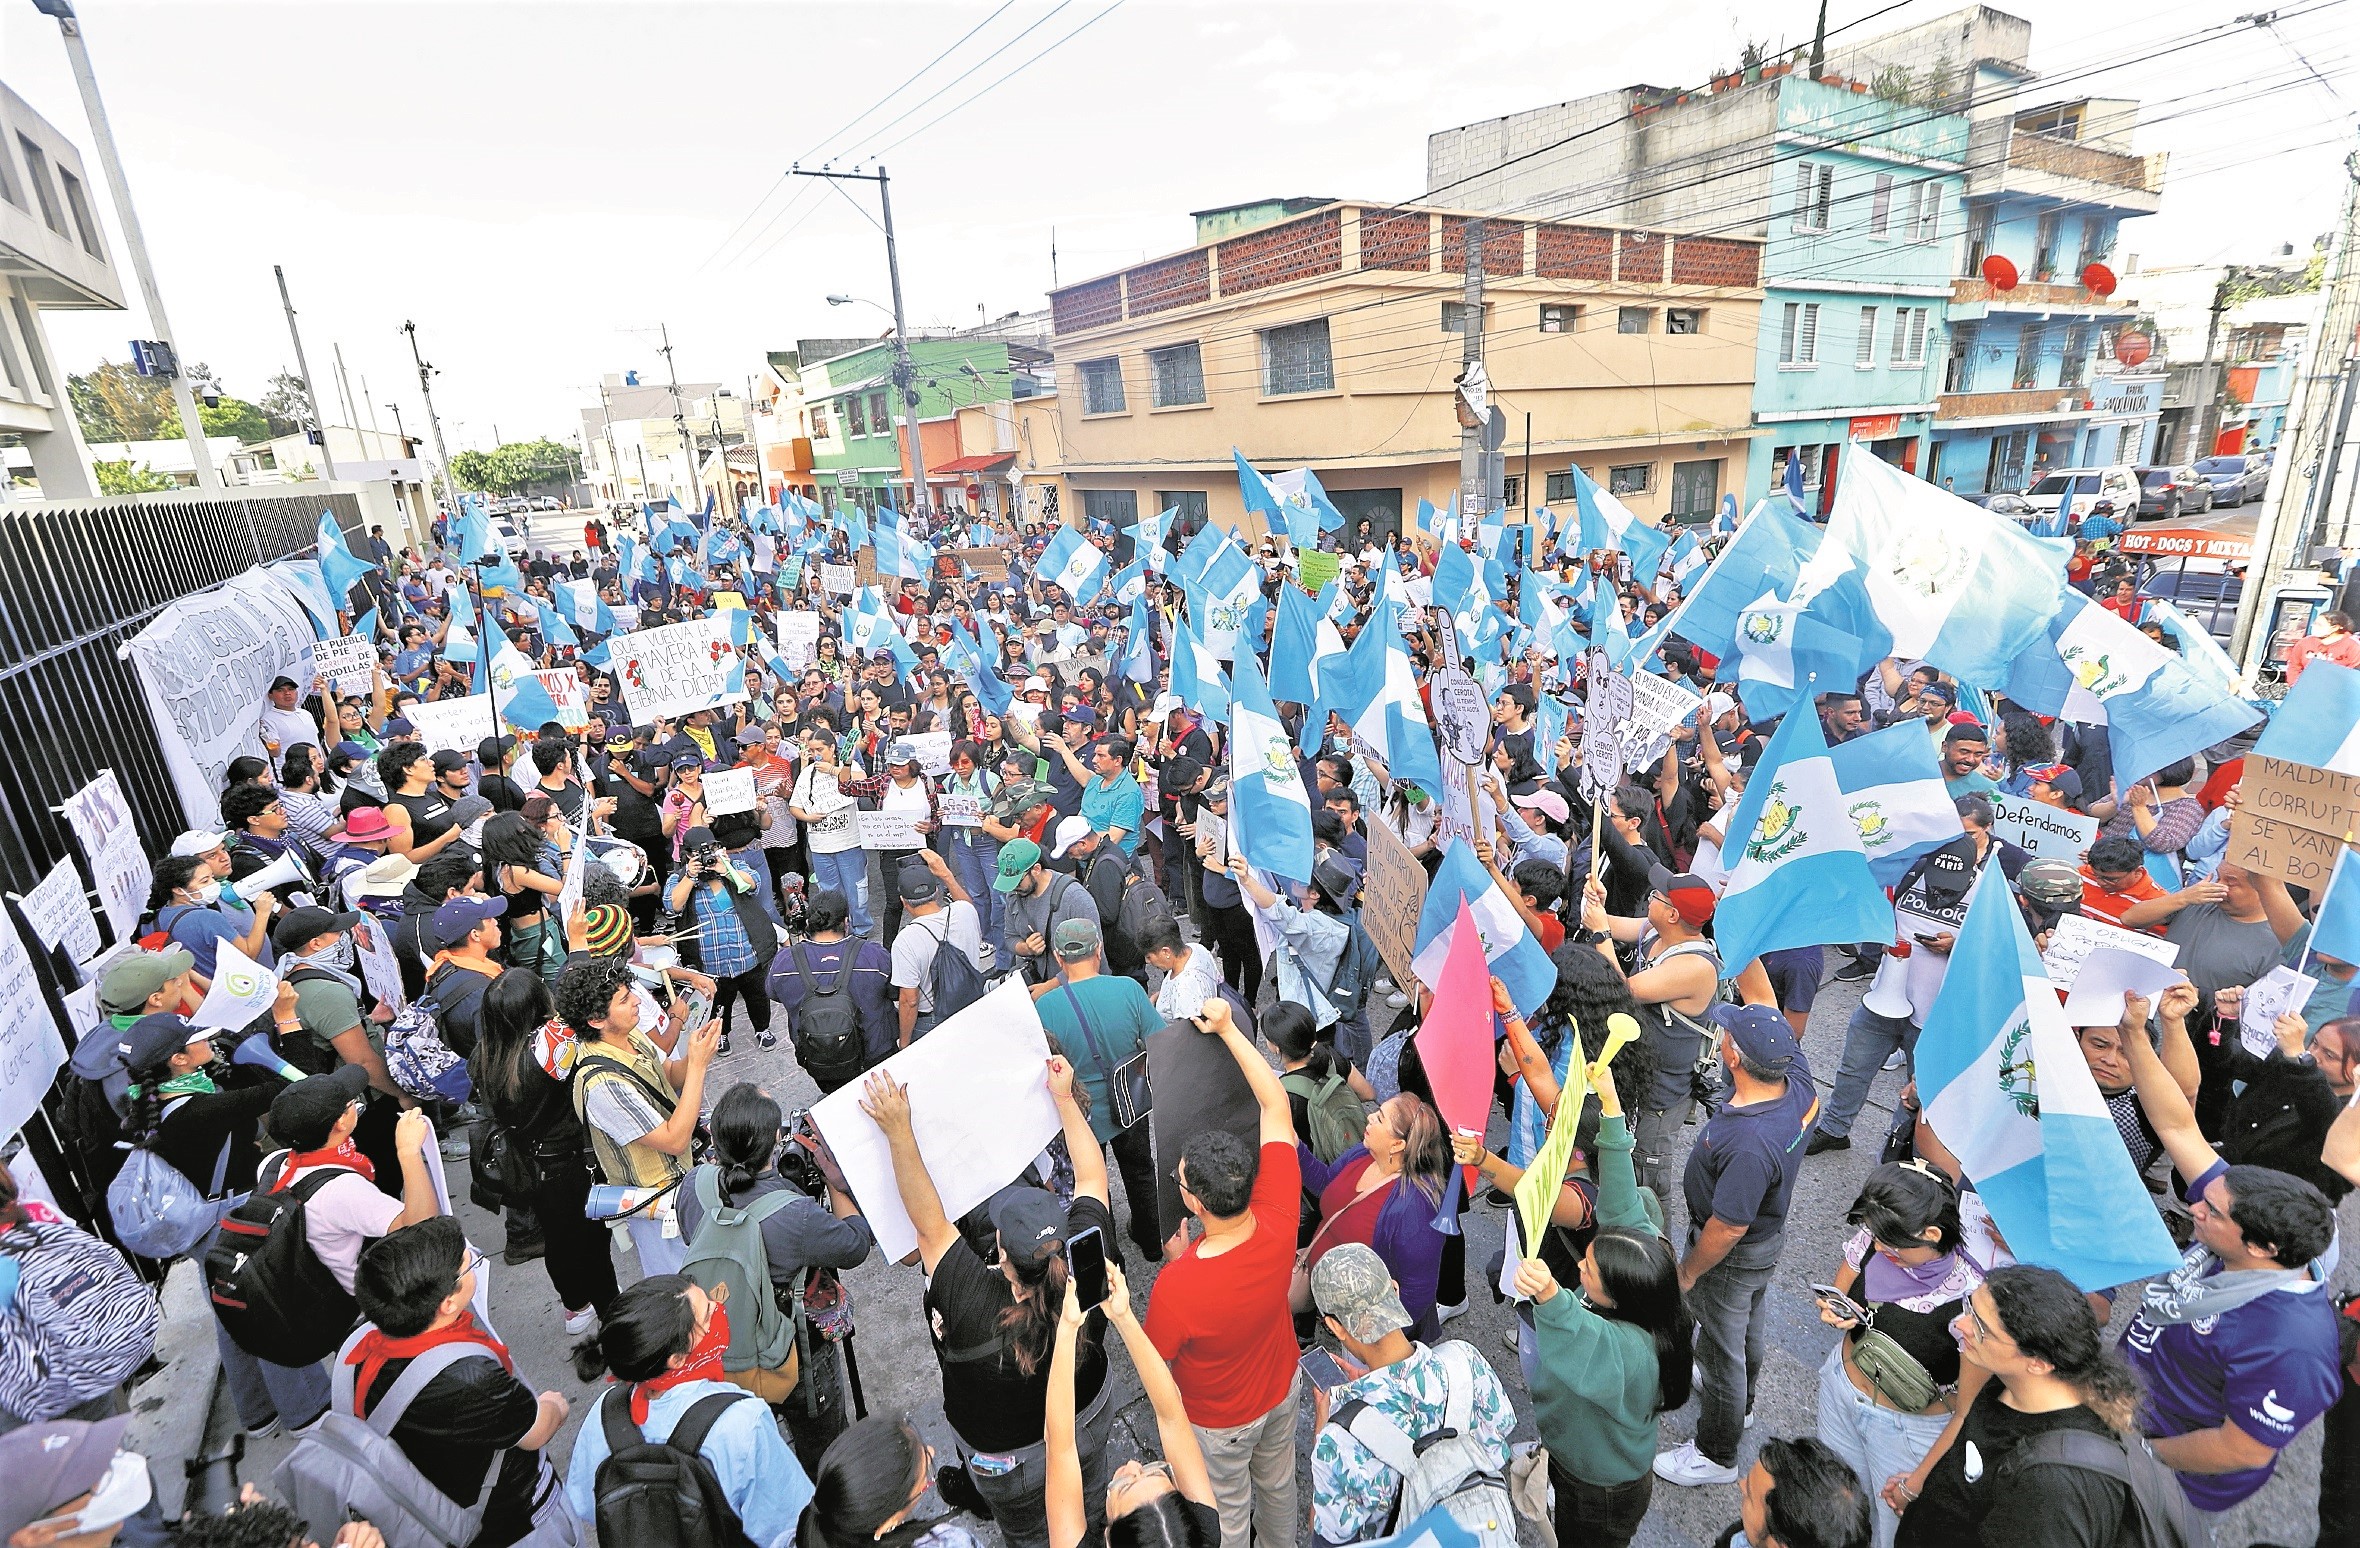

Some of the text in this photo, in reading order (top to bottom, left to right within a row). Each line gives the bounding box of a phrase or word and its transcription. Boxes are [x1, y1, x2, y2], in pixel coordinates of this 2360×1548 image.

[2196, 540, 2207, 553] Y
[2206, 540, 2251, 558] MIXTA
[274, 625, 296, 671] DE
[312, 634, 367, 652] EL PUEBLO
[612, 623, 712, 656] QUE VUELVA LA
[702, 640, 712, 654] AL
[315, 652, 330, 662] DE
[332, 646, 350, 658] PIE
[318, 650, 372, 670] CORRUPTOS DE
[321, 660, 372, 679] RODILLAS
[660, 662, 702, 684] DE LA
[566, 672, 576, 692] X
[1450, 678, 1474, 686] CONSUELO
[1634, 671, 1642, 686] EL
[1641, 675, 1665, 694] PUEBLO
[1663, 686, 1673, 700] ES
[1677, 694, 1696, 710] QUE
[628, 684, 677, 711] ETERNA
[432, 740, 450, 752] del
[1594, 740, 1614, 752] CHENCO
[1596, 750, 1613, 762] CEROTE
[1994, 803, 2082, 844] Defendamos
[2021, 830, 2038, 851] La
[2251, 818, 2336, 858] SE VAN
[1370, 825, 1418, 892] NOS QUITARON
[1934, 858, 1964, 871] PARIS
[2243, 846, 2333, 882] AL BOT
[1368, 851, 1404, 914] TANTO QUE
[1366, 875, 1401, 938] TERMINARON
[2062, 917, 2086, 932] NOS
